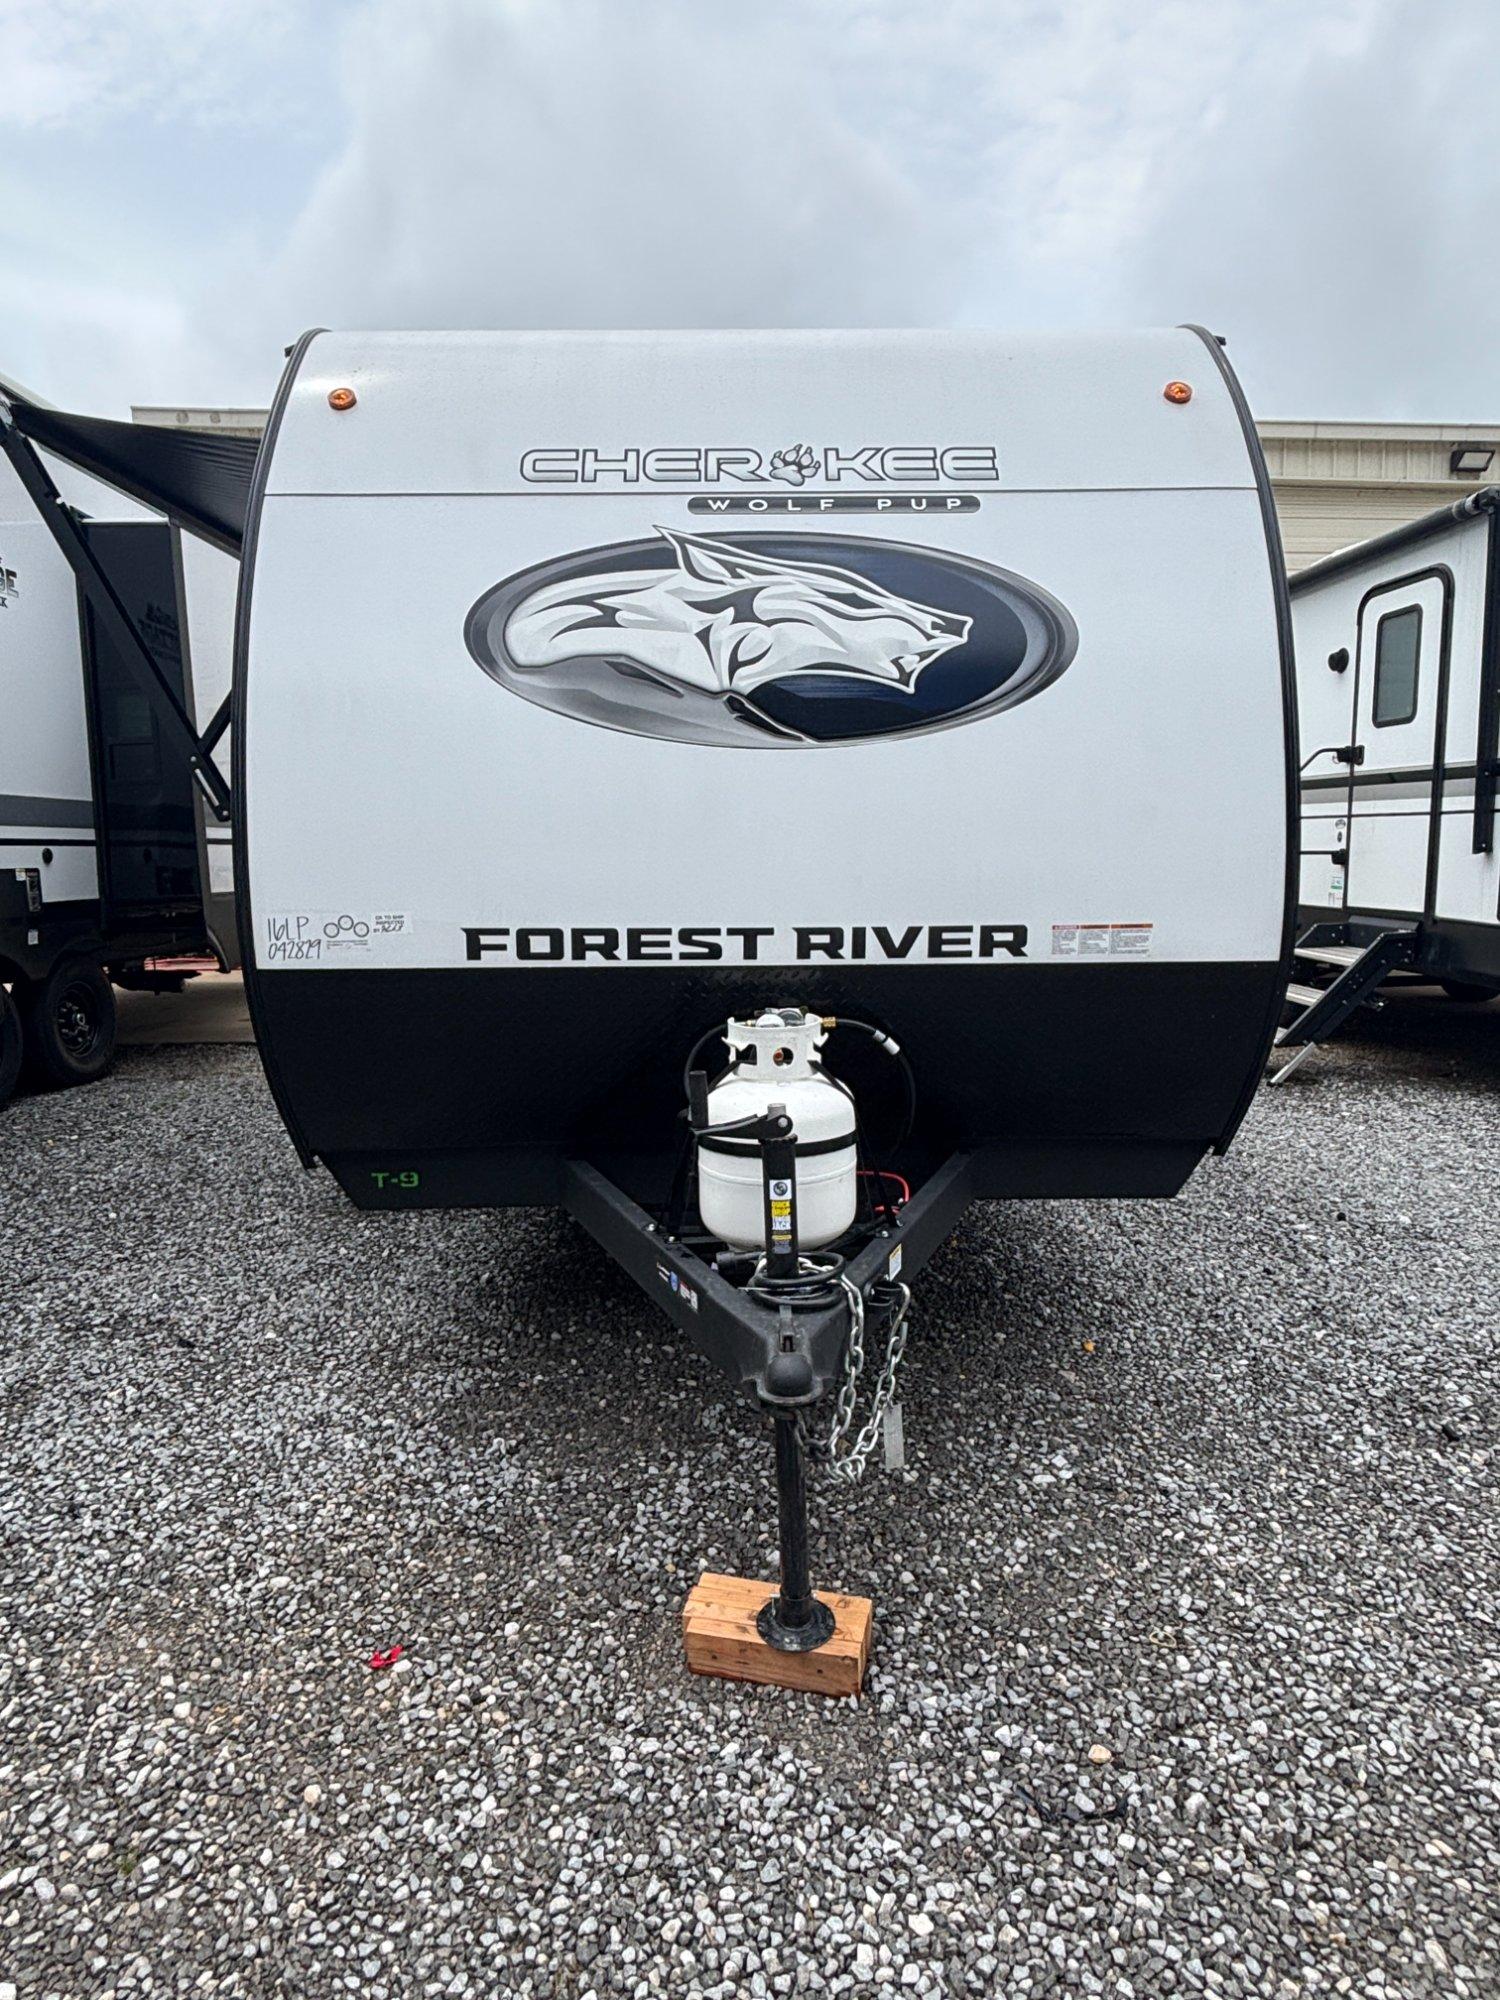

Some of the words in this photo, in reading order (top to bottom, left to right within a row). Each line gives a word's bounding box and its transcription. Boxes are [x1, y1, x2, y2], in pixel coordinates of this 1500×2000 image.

[707, 495, 837, 512] WOLF
[875, 495, 965, 512] PUP
[268, 938, 322, 961] 042829
[461, 928, 775, 962] FOREST
[792, 925, 1028, 961] RIVER
[370, 1171, 419, 1189] T-9
